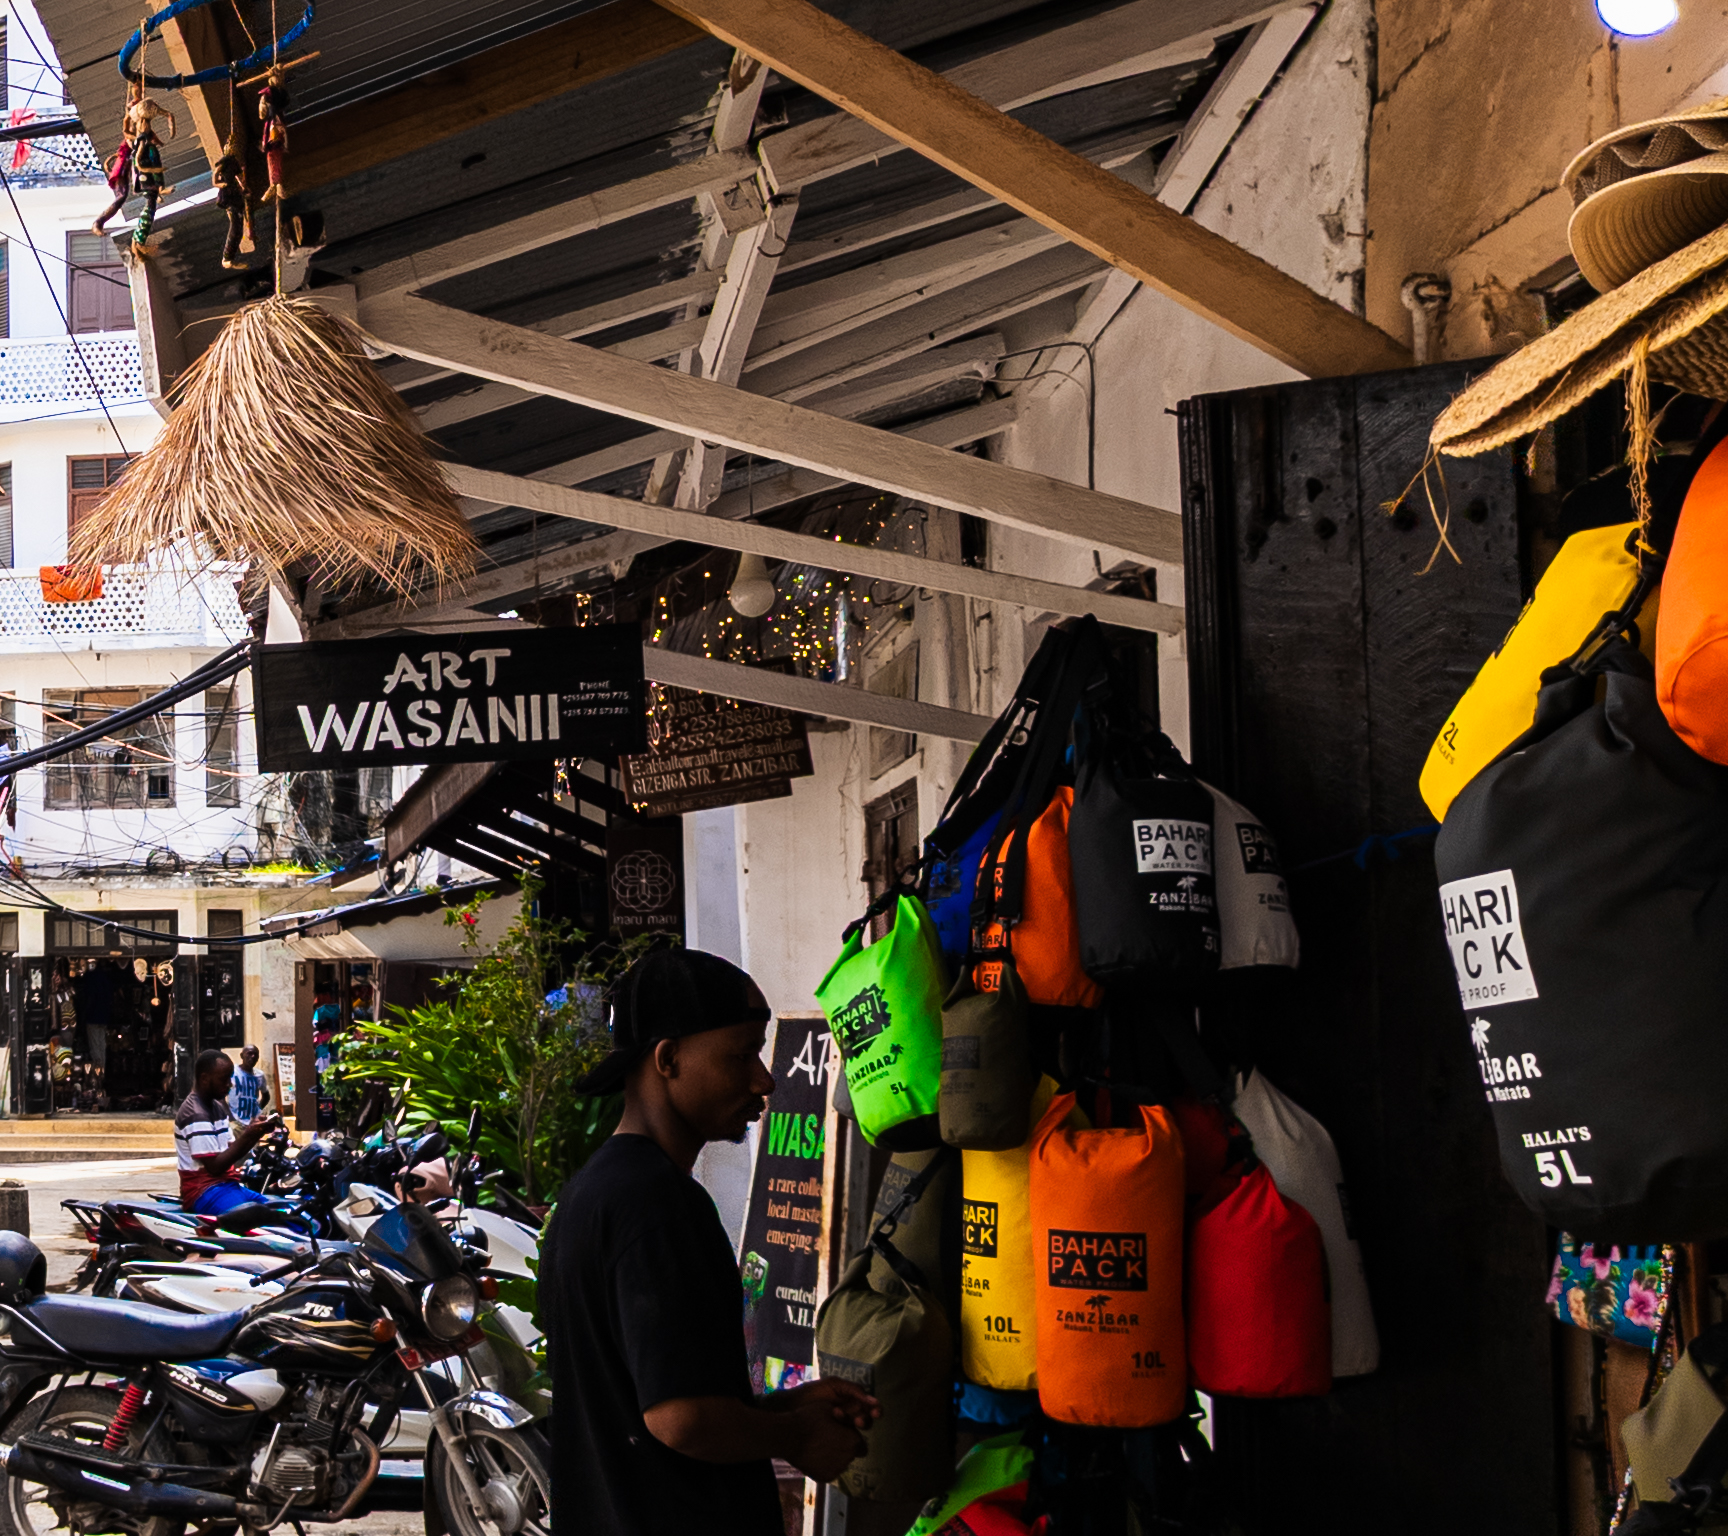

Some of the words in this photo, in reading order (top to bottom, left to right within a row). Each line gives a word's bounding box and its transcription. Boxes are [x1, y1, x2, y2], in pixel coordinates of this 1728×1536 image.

[383, 648, 511, 695] ART
[579, 680, 611, 691] PHONE
[296, 693, 561, 753] WASANII
[669, 718, 792, 752] +255242238033
[1443, 721, 1459, 751] 2L
[632, 772, 688, 796] GIZENGA
[689, 767, 716, 787] STR.
[718, 753, 801, 781] ZANZIBAR
[647, 914, 678, 925] maru
[1443, 885, 1514, 939] HARI
[1454, 931, 1524, 981] CK
[1469, 985, 1508, 1002] PROOF
[1478, 1052, 1542, 1085] ZIBAR
[890, 1081, 909, 1096] 5L
[1522, 1125, 1592, 1148] HALAI'S
[1534, 1149, 1593, 1188] 5L
[963, 1204, 996, 1226] HARI
[965, 1225, 995, 1246] CK
[1050, 1234, 1144, 1258] BAHARI
[1050, 1256, 1144, 1279] PACK
[1059, 1278, 1092, 1287] WATER
[303, 1301, 334, 1318] TVS
[1056, 1309, 1140, 1327] ZANZIBAR
[983, 1314, 1021, 1335] 10L
[1131, 1350, 1166, 1370] 10L
